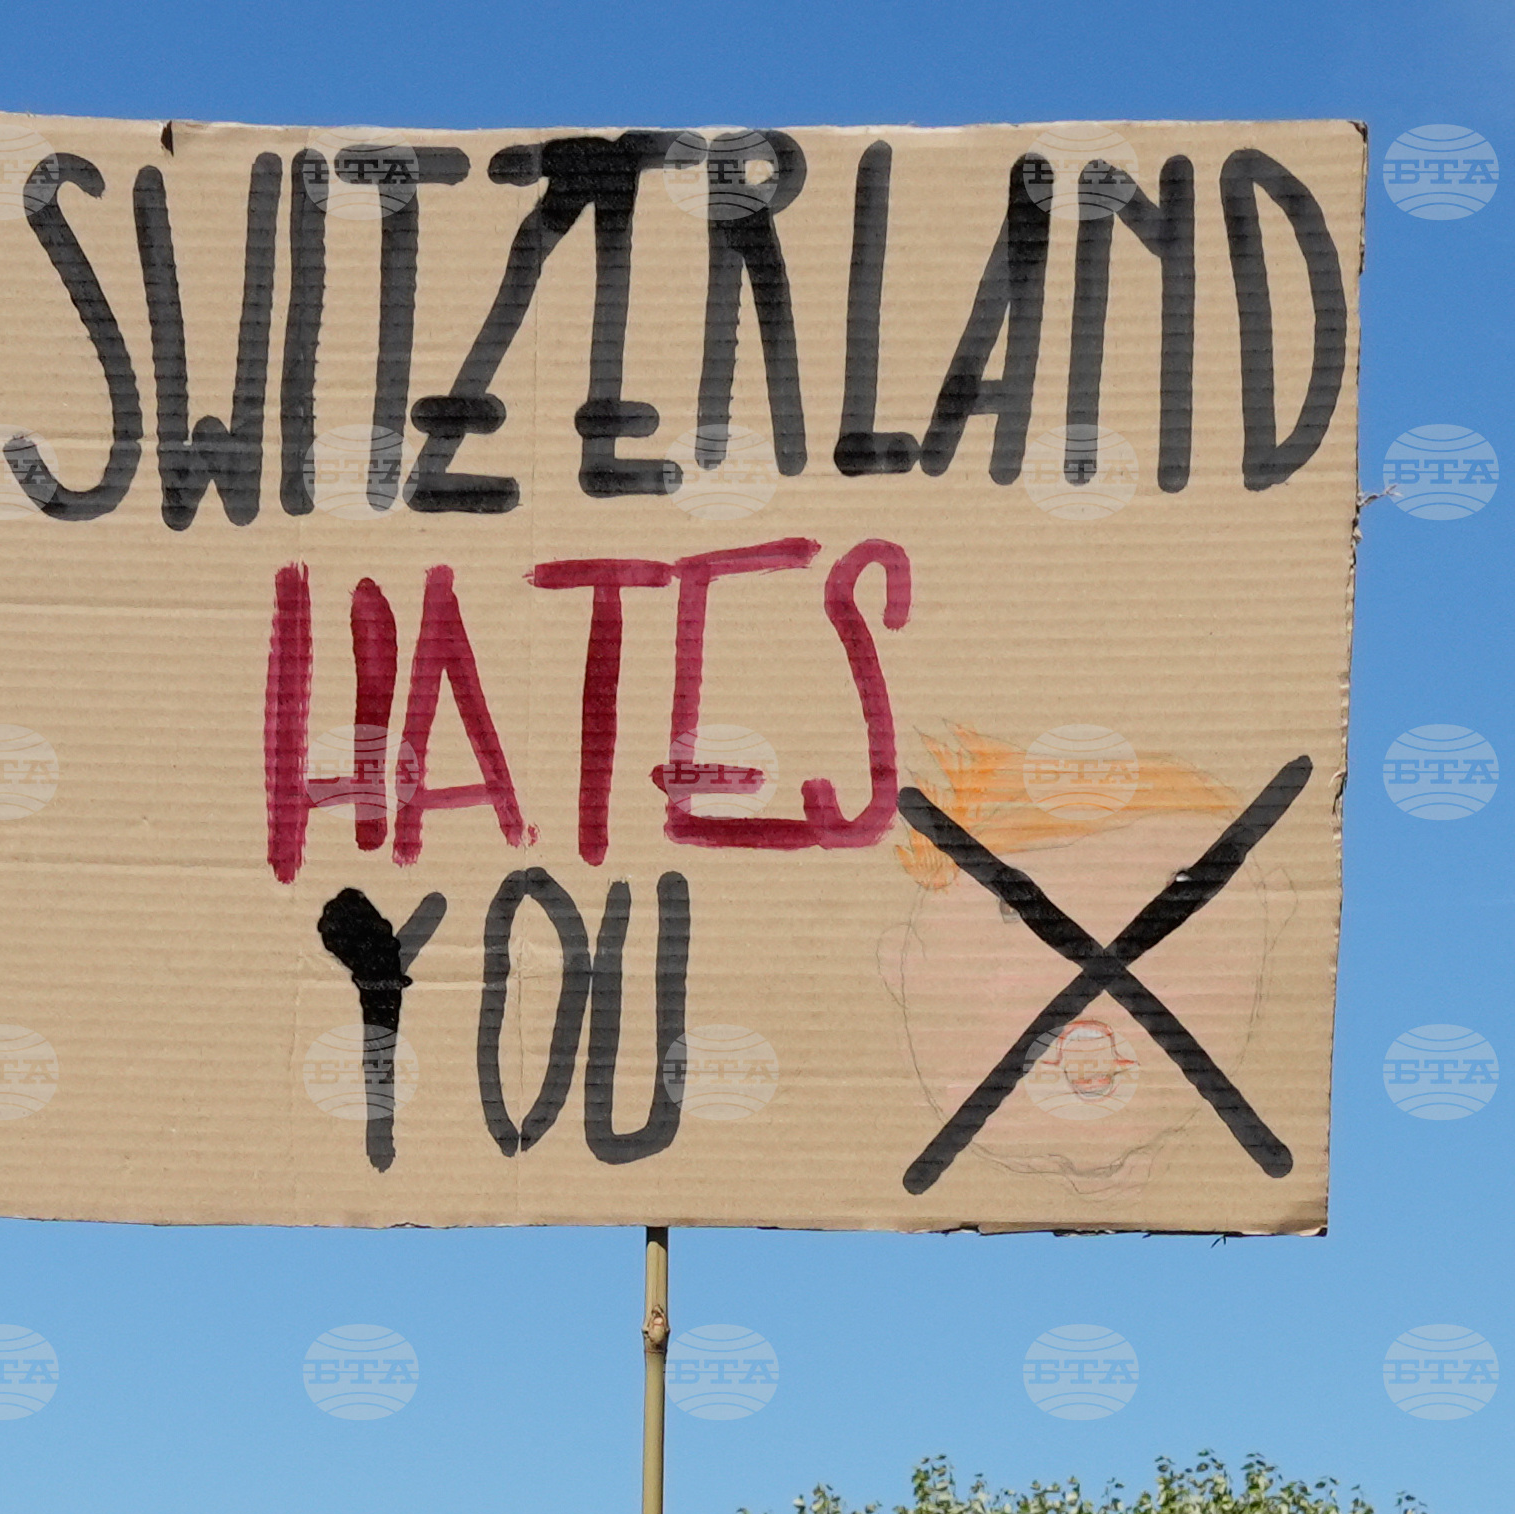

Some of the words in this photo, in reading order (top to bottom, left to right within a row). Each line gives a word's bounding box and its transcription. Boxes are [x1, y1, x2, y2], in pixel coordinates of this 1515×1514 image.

[3, 128, 1347, 531] SWITZERLAND
[264, 537, 912, 885] HATES
[317, 869, 691, 1173] YOU
